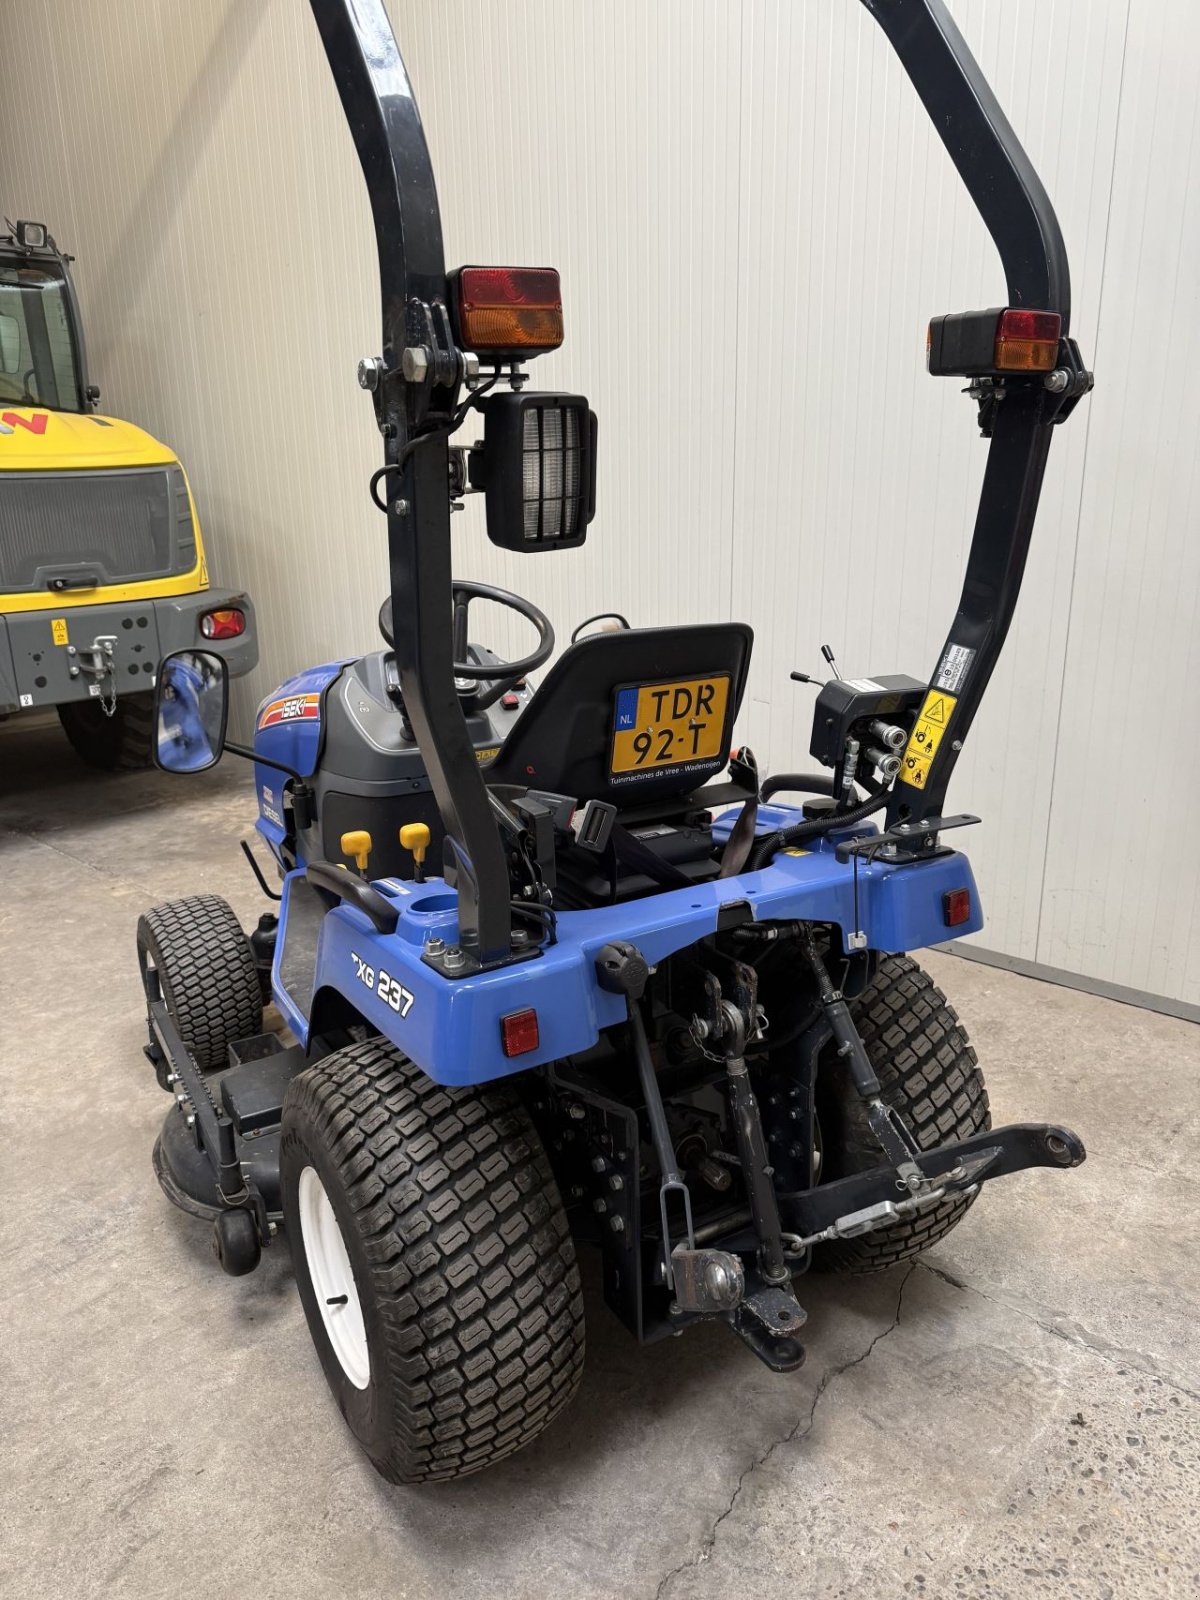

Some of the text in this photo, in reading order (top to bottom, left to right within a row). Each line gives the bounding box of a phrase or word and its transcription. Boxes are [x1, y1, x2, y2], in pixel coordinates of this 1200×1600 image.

[652, 684, 715, 722] TDR
[620, 714, 633, 725] NL
[610, 772, 654, 784] Tuinmachines
[655, 769, 664, 777] de
[665, 766, 680, 776] Vree
[377, 969, 415, 1019] 237
